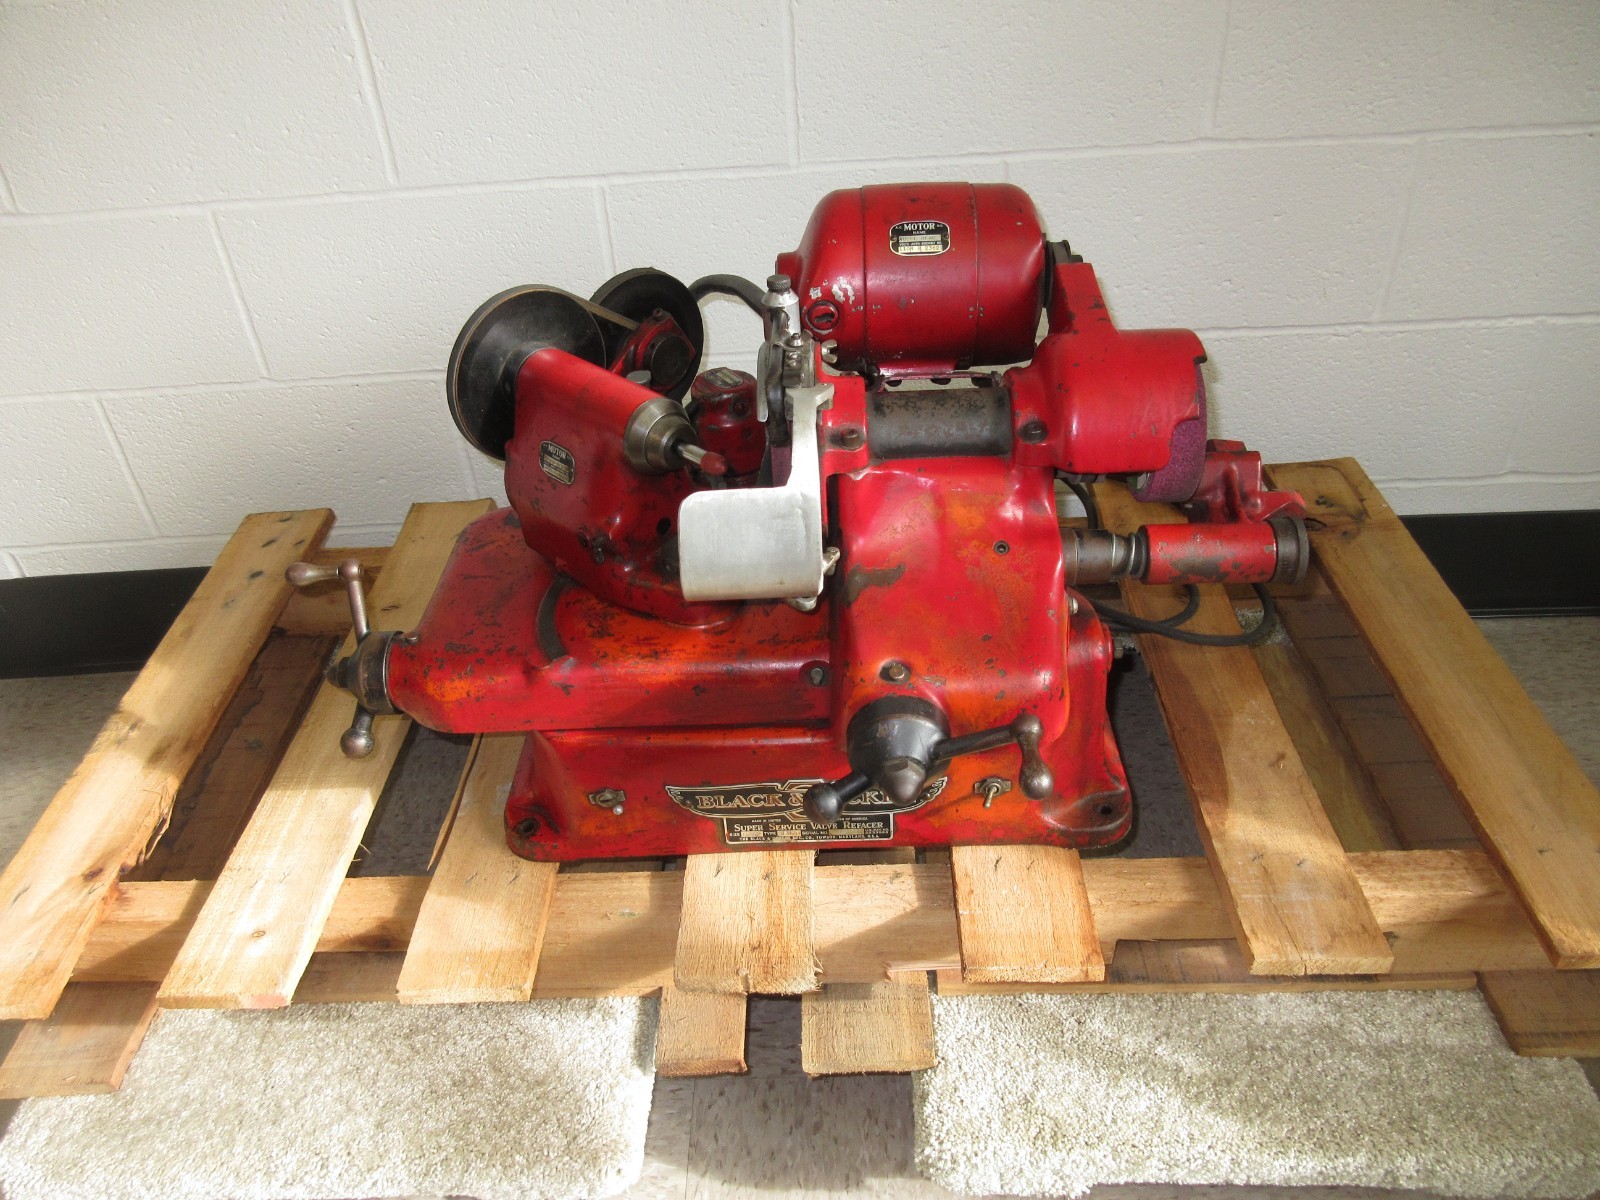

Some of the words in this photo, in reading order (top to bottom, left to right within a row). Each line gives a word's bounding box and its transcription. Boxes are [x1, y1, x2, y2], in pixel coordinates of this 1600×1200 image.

[904, 223, 935, 231] MOTOR
[548, 444, 566, 459] MOTOR
[695, 794, 786, 808] BLACK
[734, 823, 764, 832] SUPER
[768, 822, 807, 831] SERVICE
[810, 822, 838, 830] VALVE
[843, 821, 884, 829] REFACER
